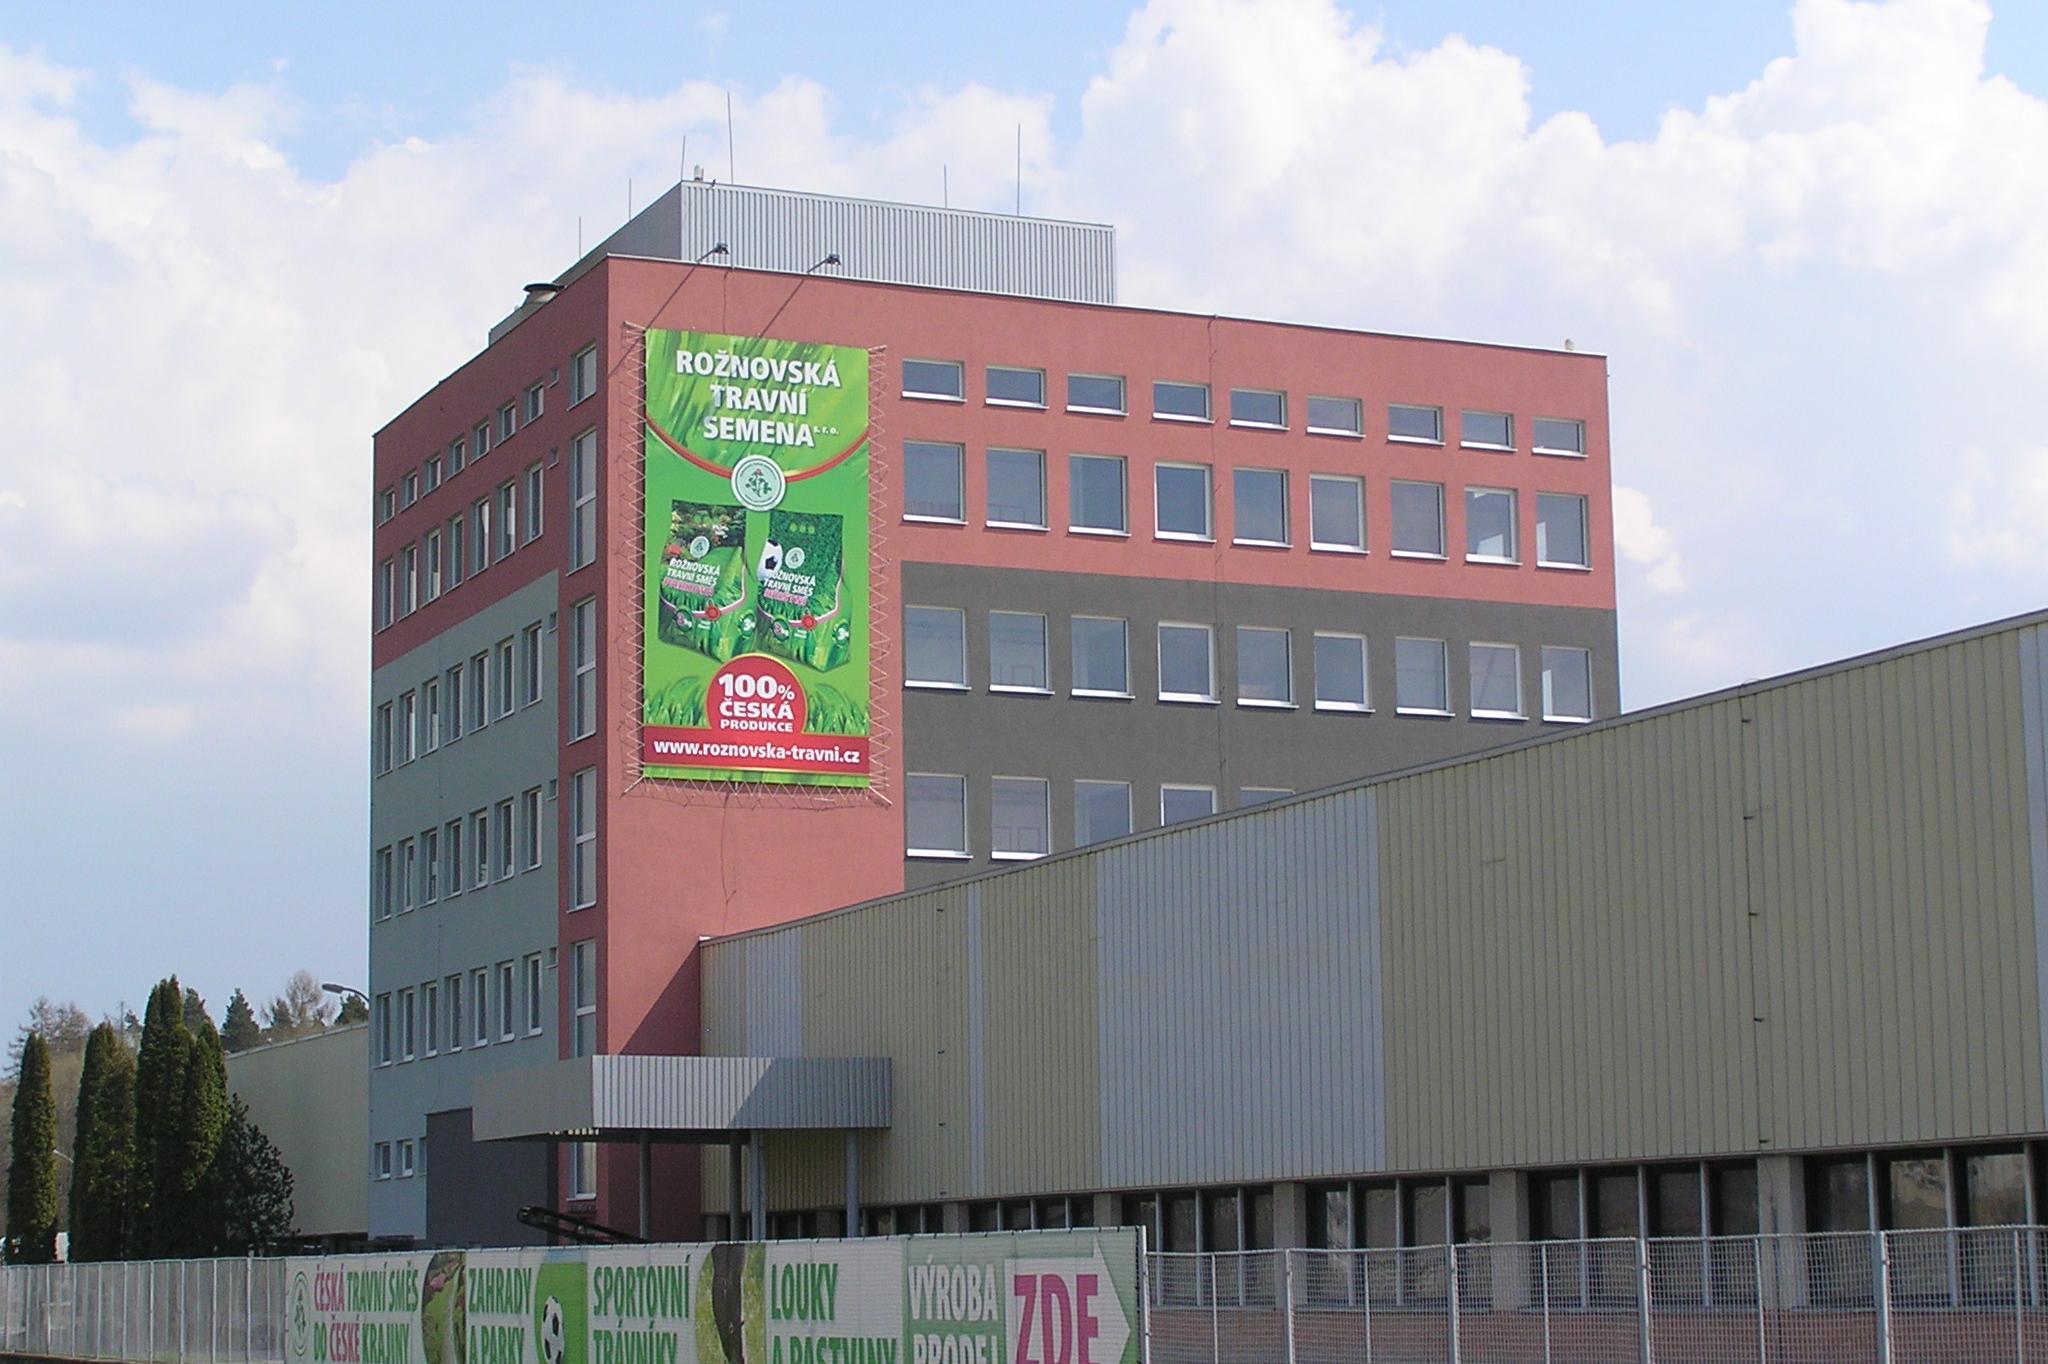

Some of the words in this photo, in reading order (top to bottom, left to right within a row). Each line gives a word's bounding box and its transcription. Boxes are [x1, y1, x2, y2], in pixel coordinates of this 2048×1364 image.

[675, 350, 841, 387] ROŽNOVSKÁ
[710, 384, 808, 415] TRAVNÍ
[703, 416, 815, 447] SEMENA
[718, 673, 795, 700] 100%
[719, 698, 794, 720] ČESKÁ
[720, 718, 793, 733] PRODUKCE
[653, 740, 860, 763] www.roznovska-travni.cz
[314, 1263, 345, 1312] ČESKÁ
[346, 1261, 388, 1312] TRAVNÍ
[388, 1260, 419, 1312] SMĚS
[468, 1267, 532, 1314] ZAHRADY
[593, 1254, 690, 1319] SPORTOVNÍ
[771, 1263, 838, 1320] LOUKY
[908, 1254, 998, 1321] VÝROBA
[313, 1322, 327, 1362] DO
[329, 1313, 360, 1363] ČESKÉ
[361, 1322, 410, 1364] KRAJINY
[1014, 1273, 1099, 1364] ZDE
[468, 1325, 477, 1364] A
[480, 1325, 525, 1364] PARKY
[593, 1320, 678, 1364] TRÁVNÍKY
